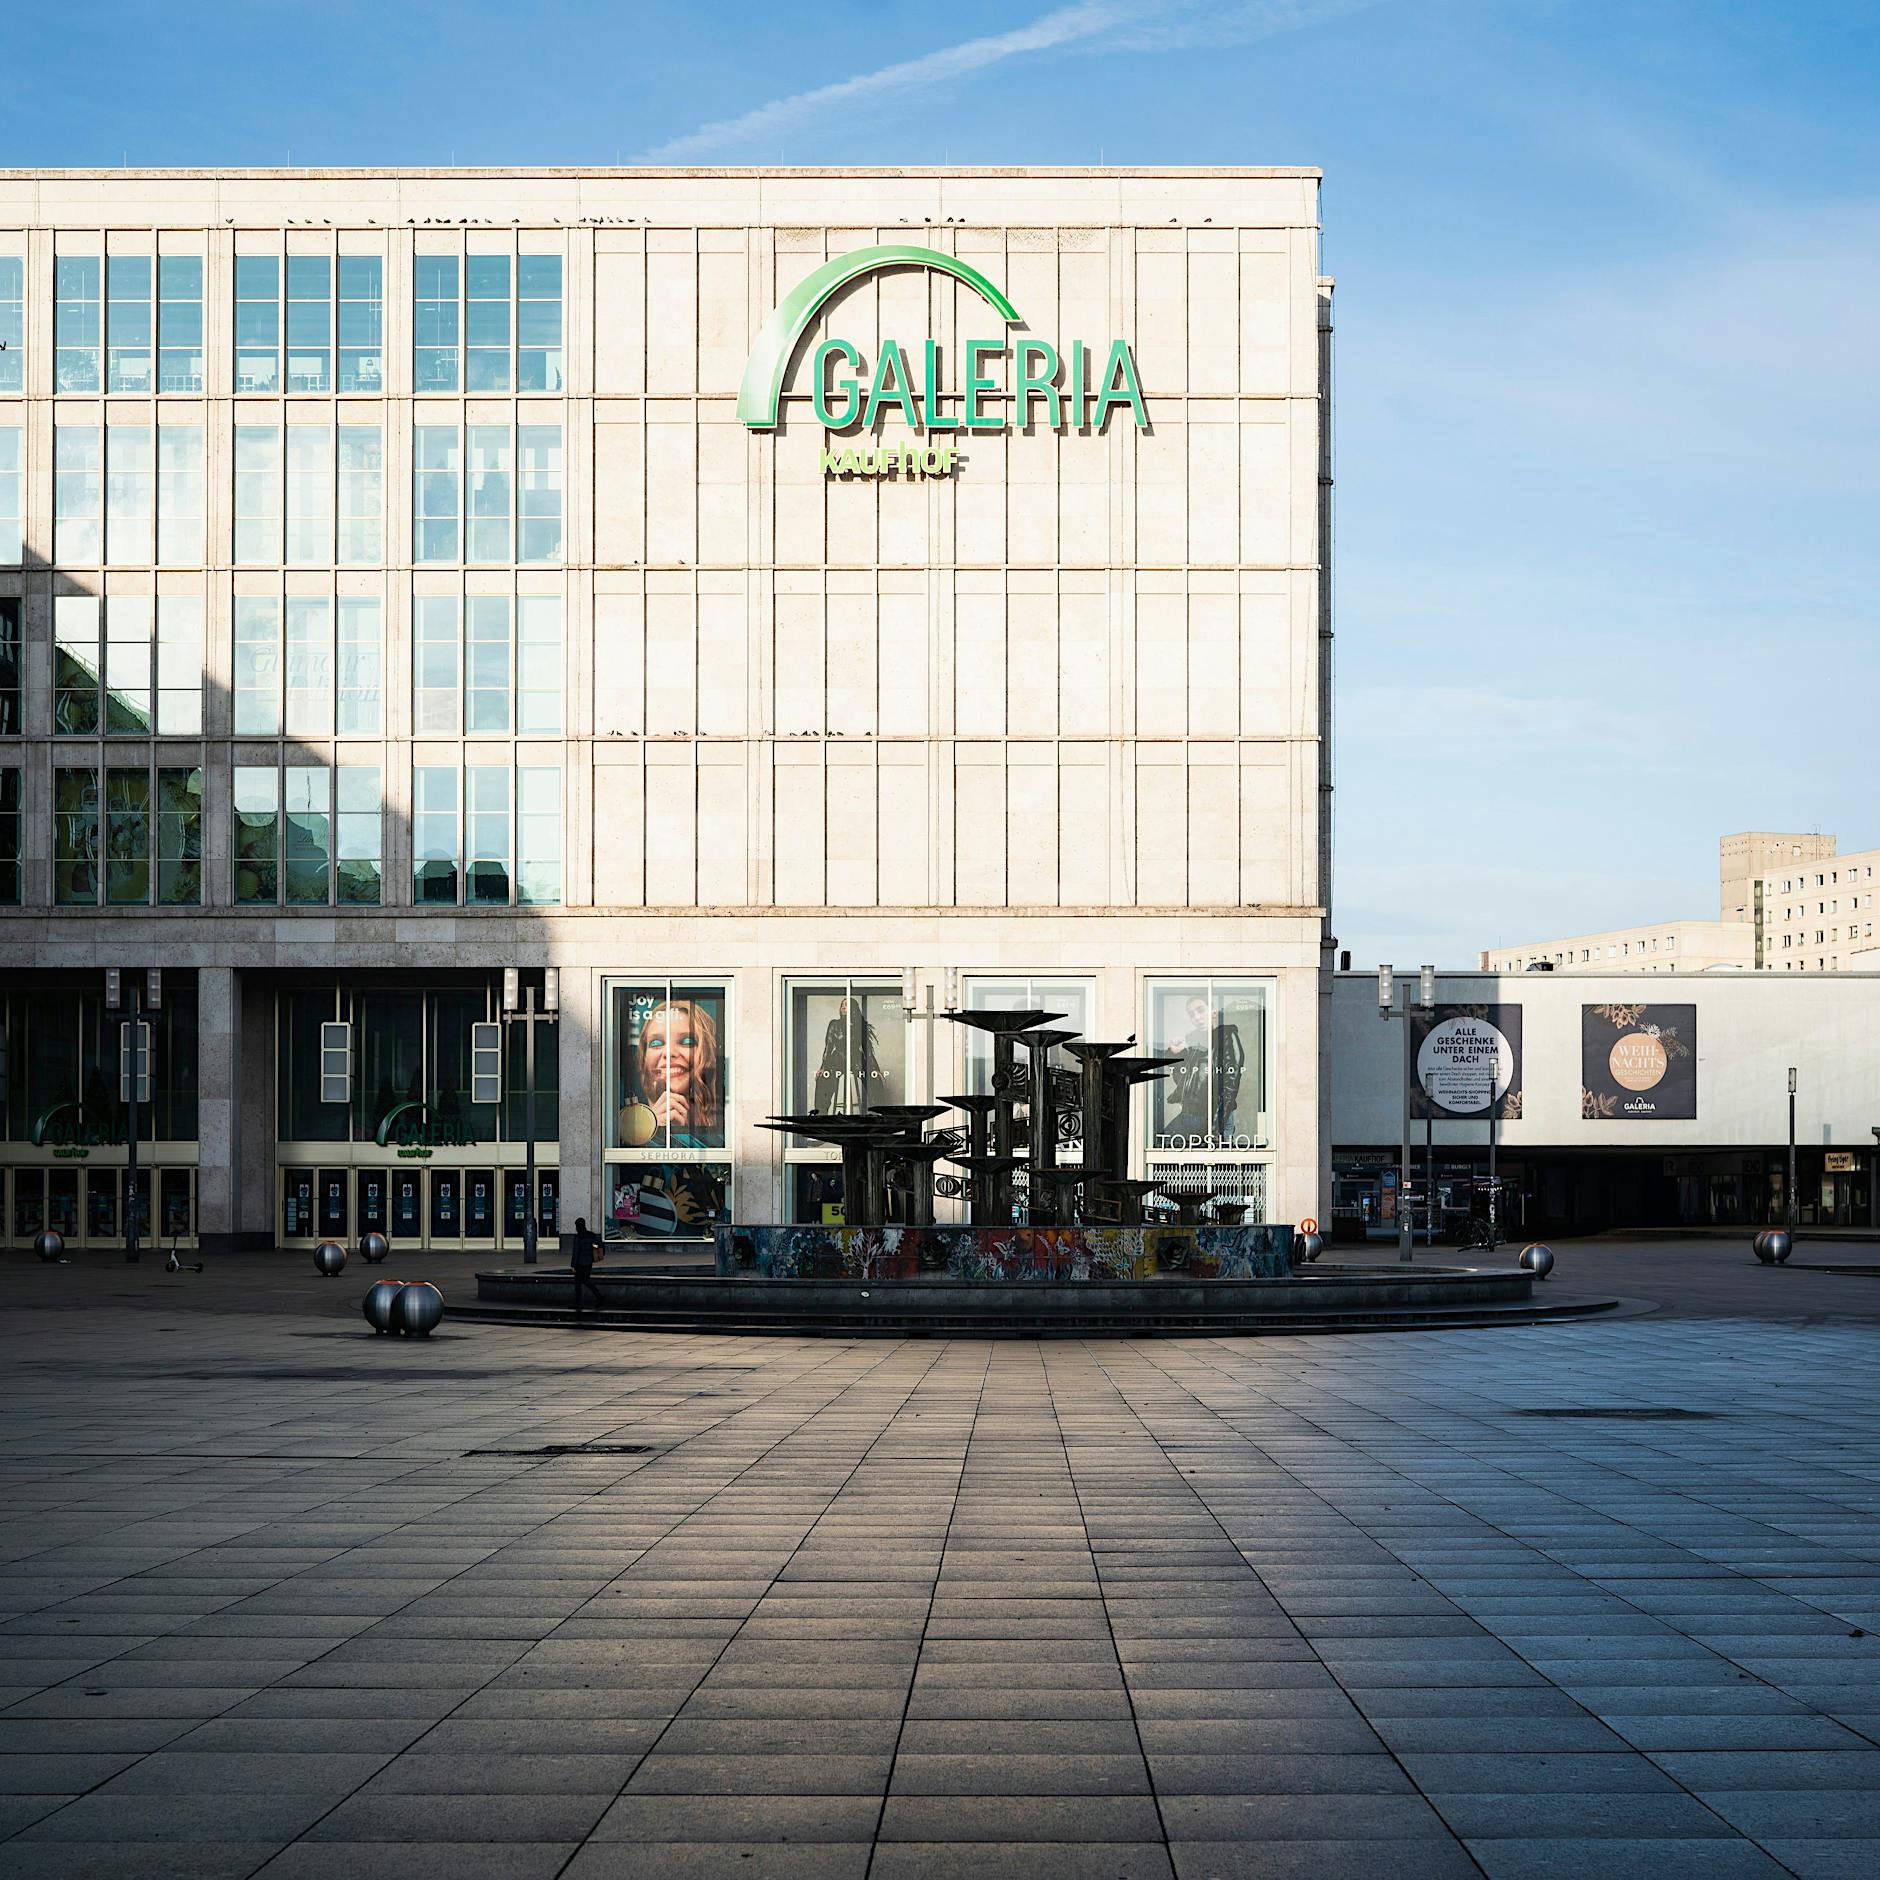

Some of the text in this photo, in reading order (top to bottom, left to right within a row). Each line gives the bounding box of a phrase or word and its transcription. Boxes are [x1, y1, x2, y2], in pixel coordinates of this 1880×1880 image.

[812, 337, 1149, 430] GALERIA
[628, 994, 655, 1009] Joy
[628, 1008, 641, 1020] is
[643, 1010, 653, 1020] a
[1455, 1028, 1477, 1036] ALLE
[1437, 1037, 1495, 1045] GESCHENKE
[1433, 1046, 1499, 1054] UNTER EINEM
[1618, 1045, 1659, 1057] WEIH-
[1452, 1055, 1479, 1063] DACH
[1612, 1057, 1665, 1068] NACHTS
[811, 1070, 890, 1078] OPHOP
[395, 1121, 477, 1146] GALERIA
[1156, 1133, 1269, 1152] TOPSHOP
[641, 1151, 696, 1160] SEPHORA
